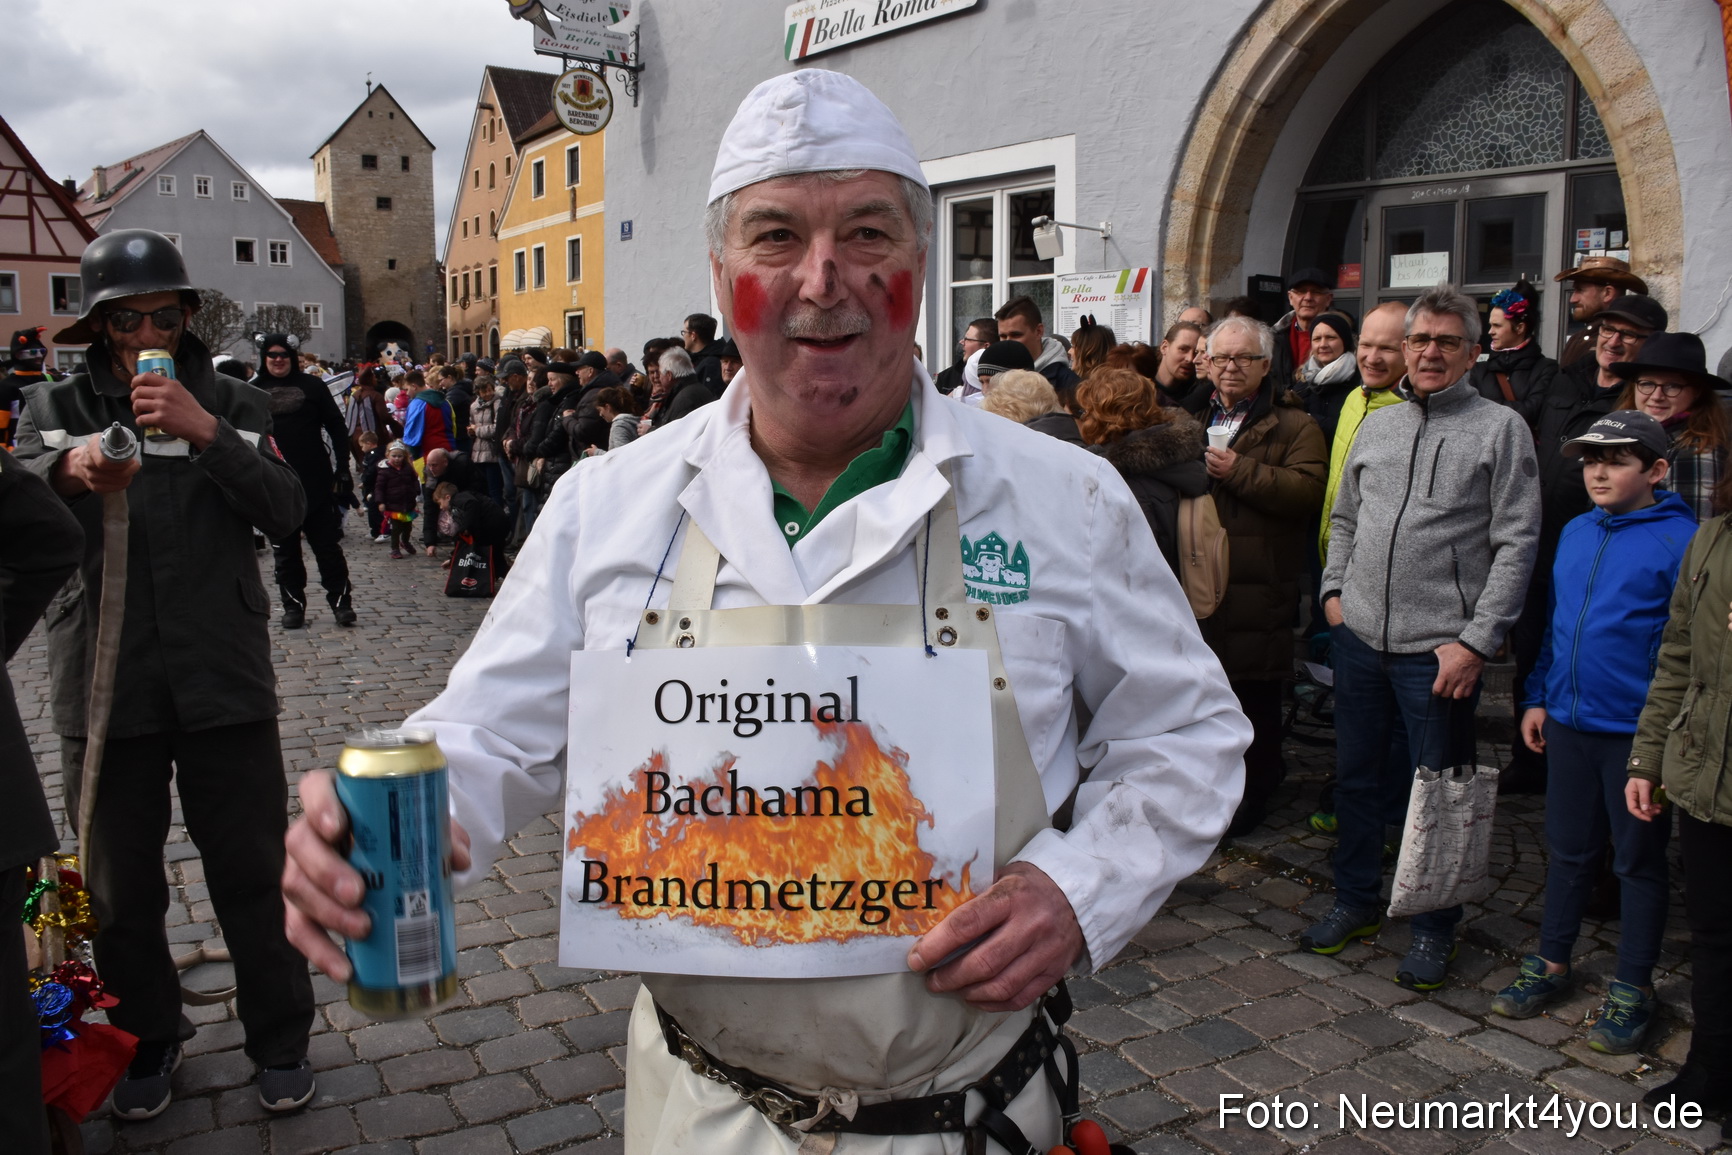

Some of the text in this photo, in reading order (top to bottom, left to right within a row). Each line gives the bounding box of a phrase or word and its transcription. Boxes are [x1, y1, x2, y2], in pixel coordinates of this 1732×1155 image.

[555, 3, 608, 23] Eisdiele
[813, 0, 936, 46] Bella Roma
[540, 38, 579, 51] Roma
[565, 33, 601, 47] Bella
[569, 118, 597, 127] BERCHING
[1393, 255, 1429, 269] Urlaub
[1062, 284, 1092, 295] Bella
[1072, 294, 1106, 303] Roma
[654, 675, 862, 738] Original
[643, 769, 873, 817] Bachama
[578, 860, 943, 926] Brandmetzger
